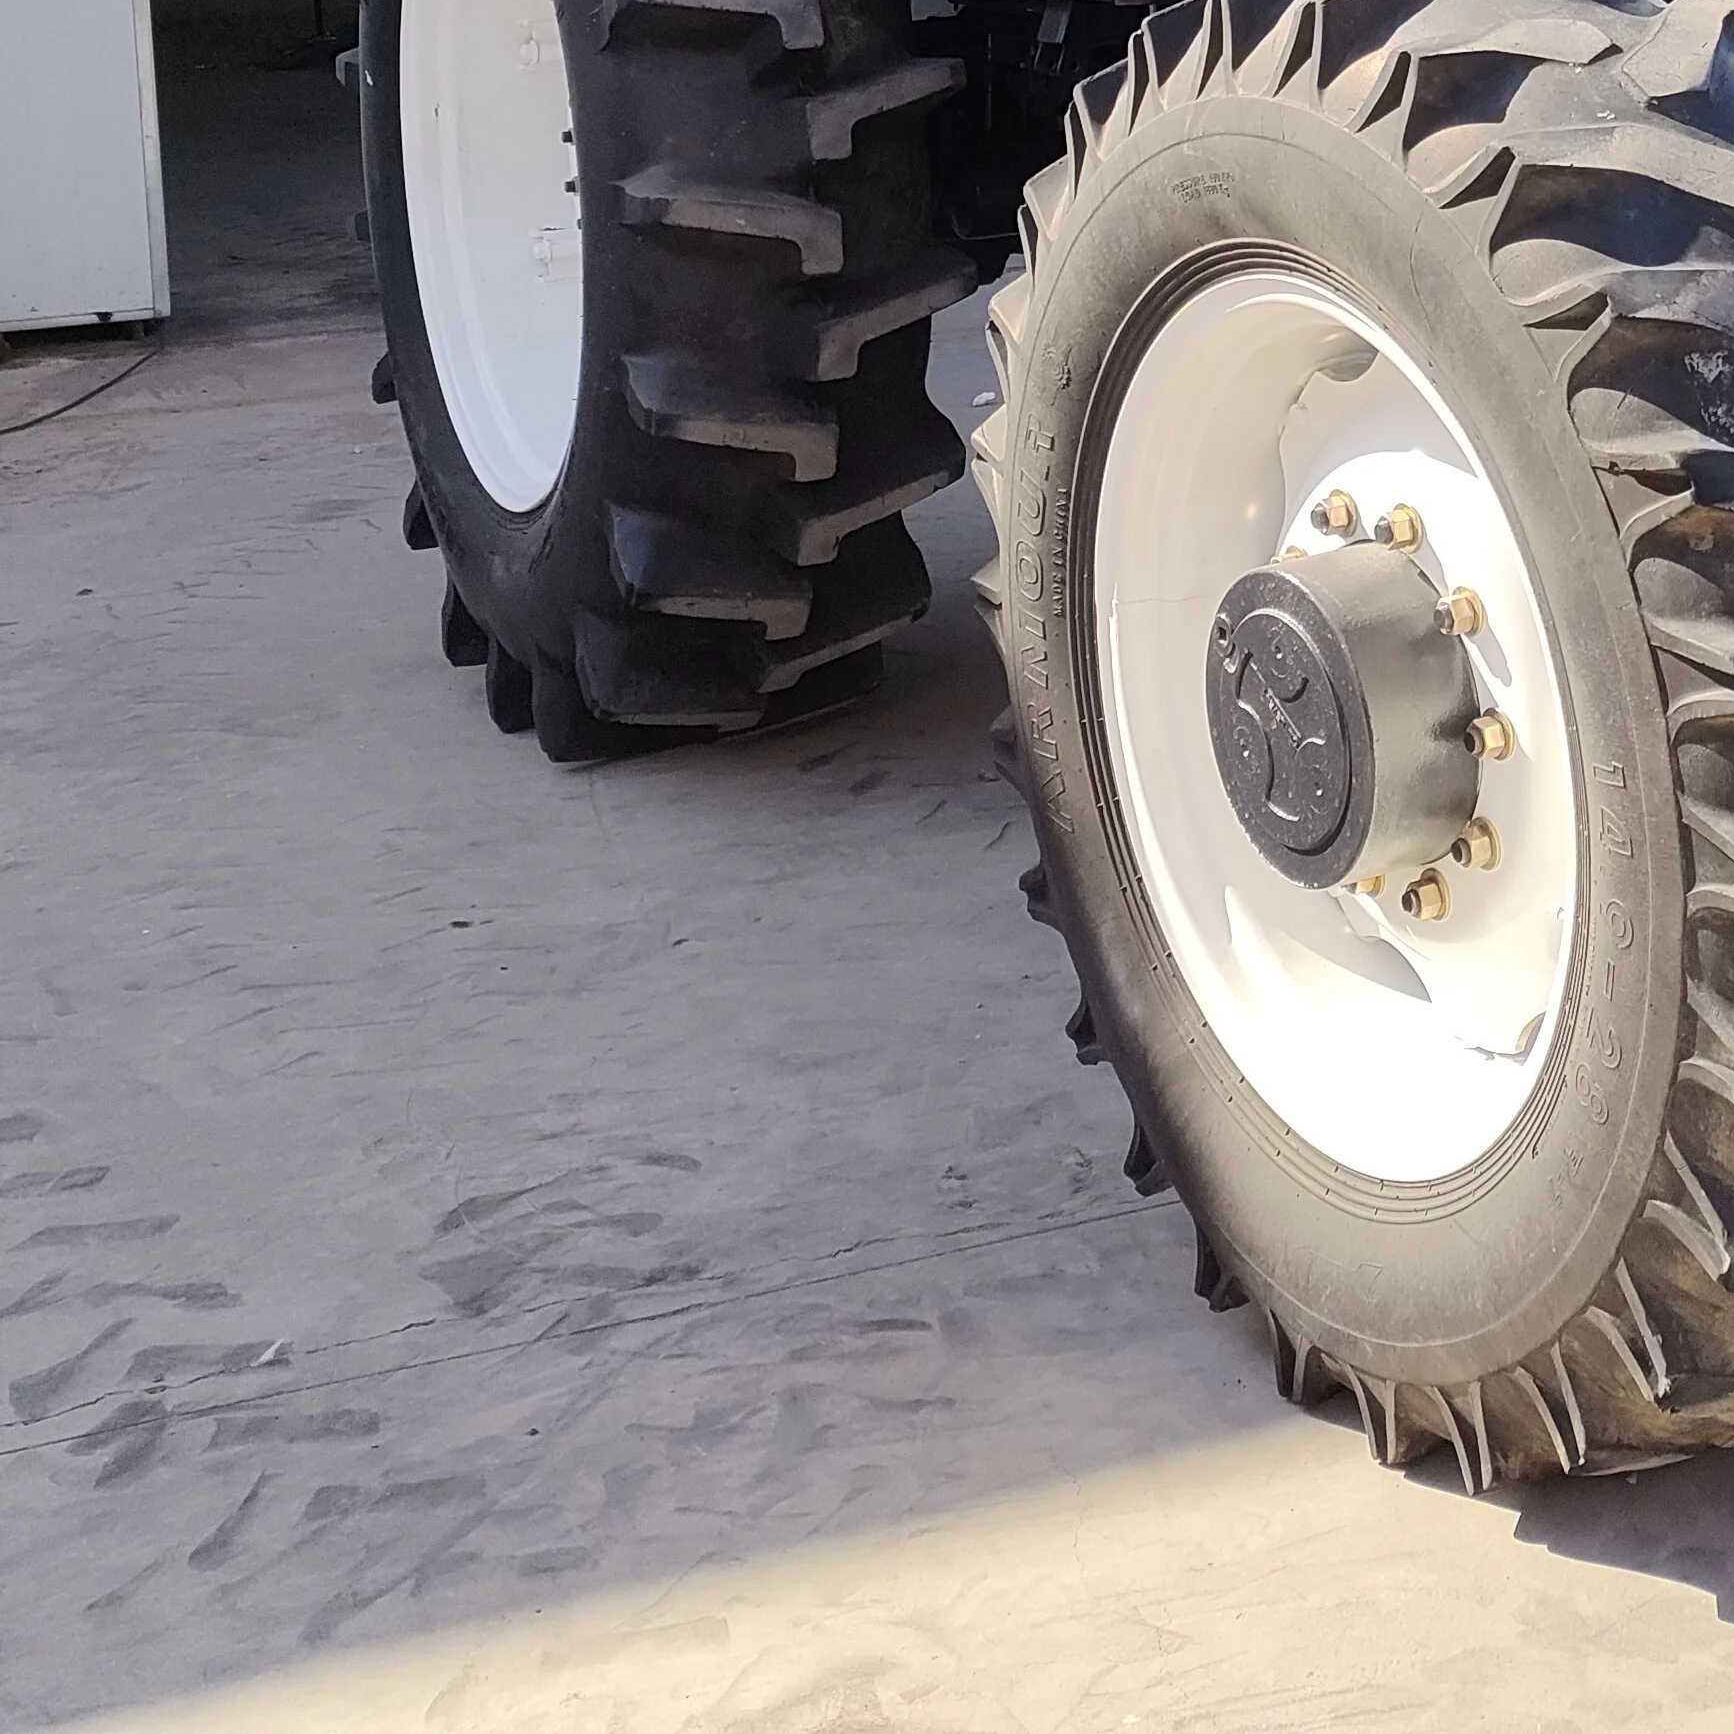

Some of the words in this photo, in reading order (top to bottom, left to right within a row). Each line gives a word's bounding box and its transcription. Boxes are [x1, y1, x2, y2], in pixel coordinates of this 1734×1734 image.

[1052, 487, 1070, 544] CHINA
[1051, 544, 1067, 570] IN
[1051, 572, 1067, 618] MADE
[1014, 411, 1074, 833] ARMOUR
